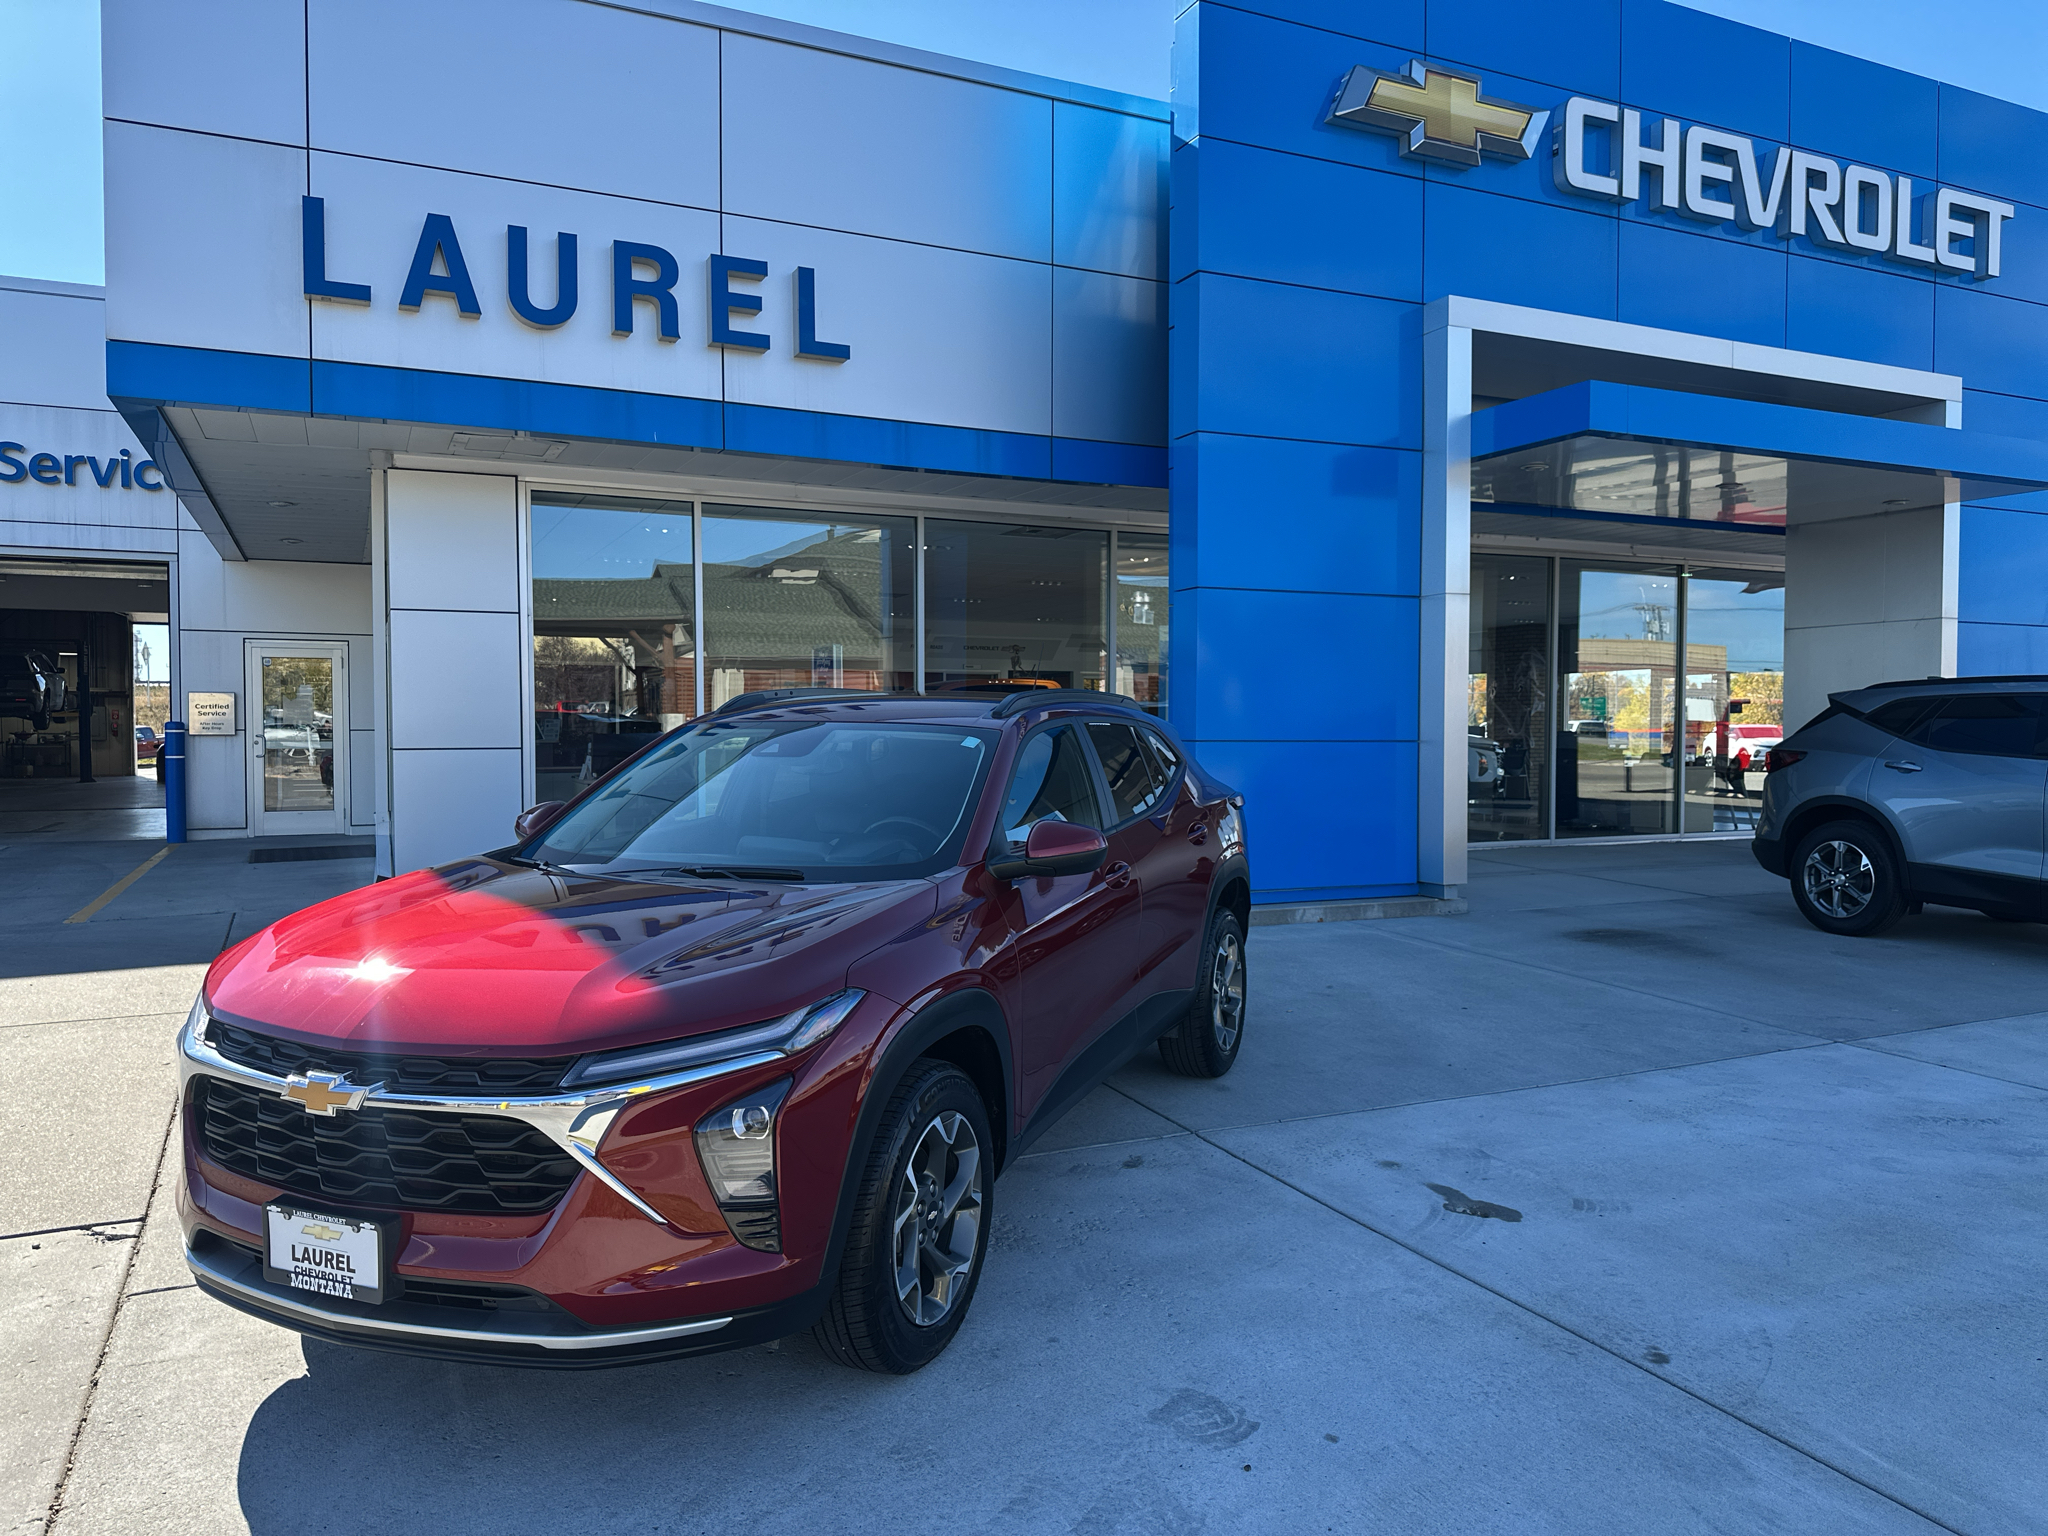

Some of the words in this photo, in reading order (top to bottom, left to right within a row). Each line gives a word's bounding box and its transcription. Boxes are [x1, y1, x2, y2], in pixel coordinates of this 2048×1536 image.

[1557, 96, 2015, 281] CHEVROLET
[302, 194, 851, 364] LAUREL
[0, 441, 170, 491] Servic
[293, 1209, 313, 1220] LAUREL
[313, 1213, 346, 1225] CHEVROLET
[291, 1243, 356, 1274] LAUREL
[290, 1273, 353, 1299] MONTANA
[294, 1264, 354, 1285] CHEVROLET
